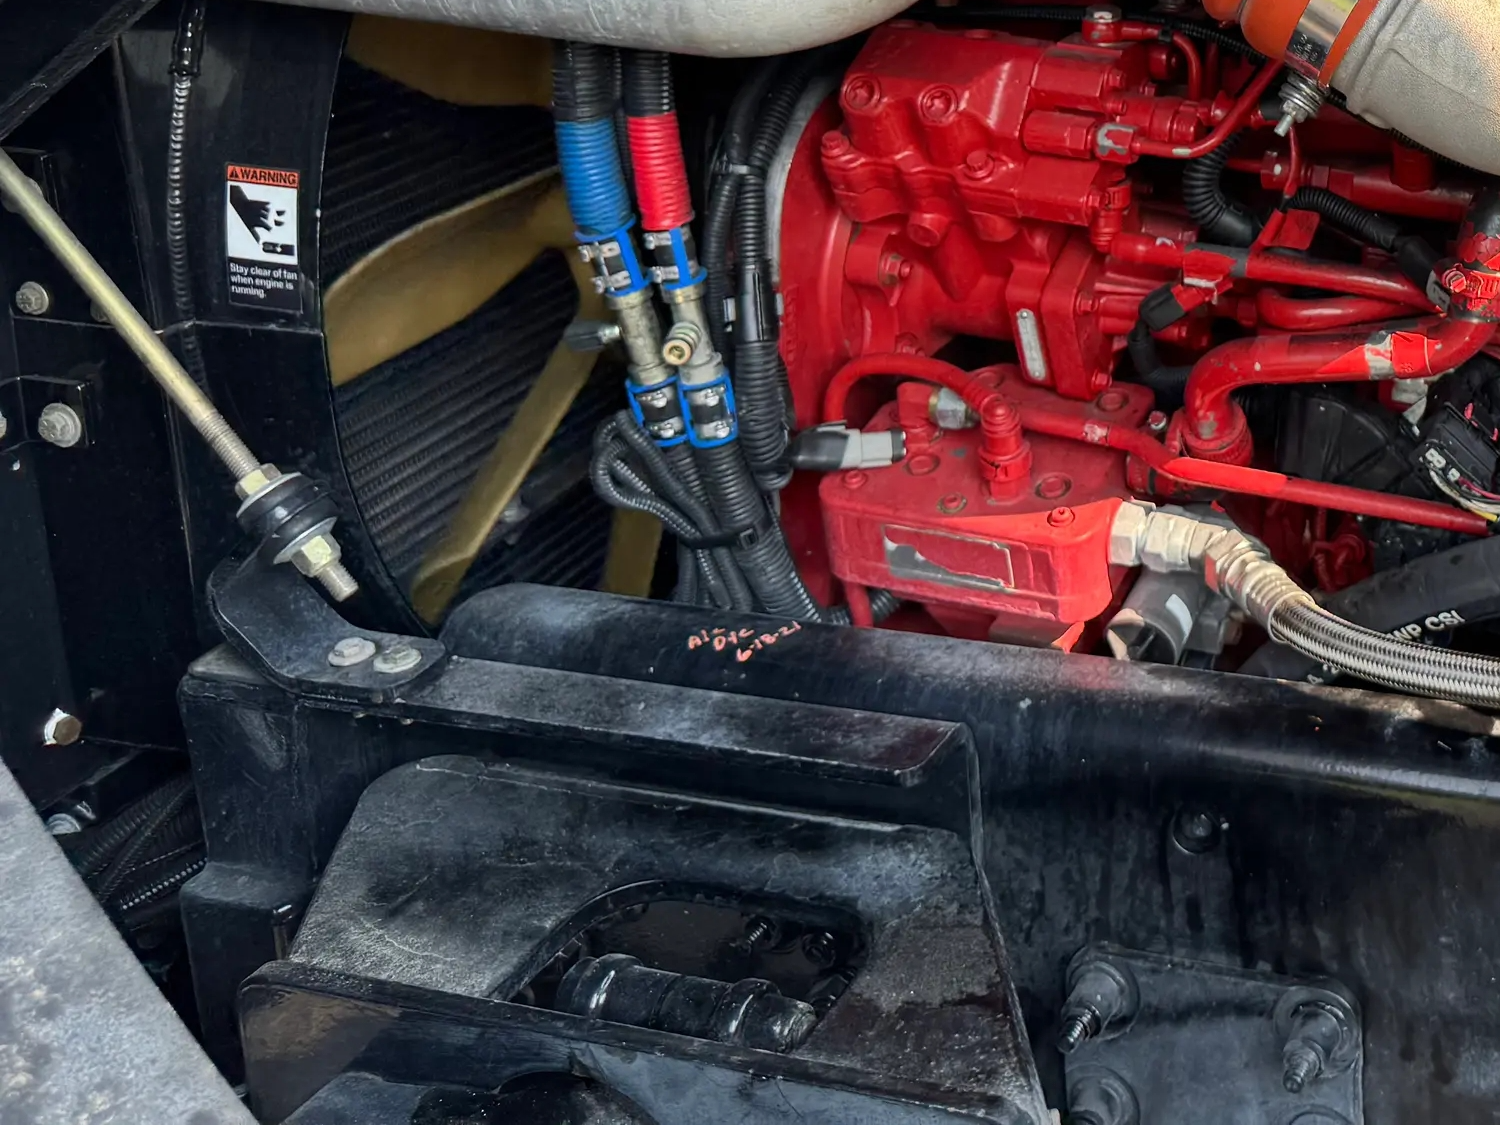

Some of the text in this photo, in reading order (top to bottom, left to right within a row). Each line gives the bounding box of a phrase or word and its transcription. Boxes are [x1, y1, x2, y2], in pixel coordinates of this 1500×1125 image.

[240, 167, 297, 185] WARNING
[230, 262, 298, 280] Stay clear of fan
[230, 275, 294, 290] when engine is
[231, 285, 267, 299] running.
[1425, 609, 1466, 631] CSI
